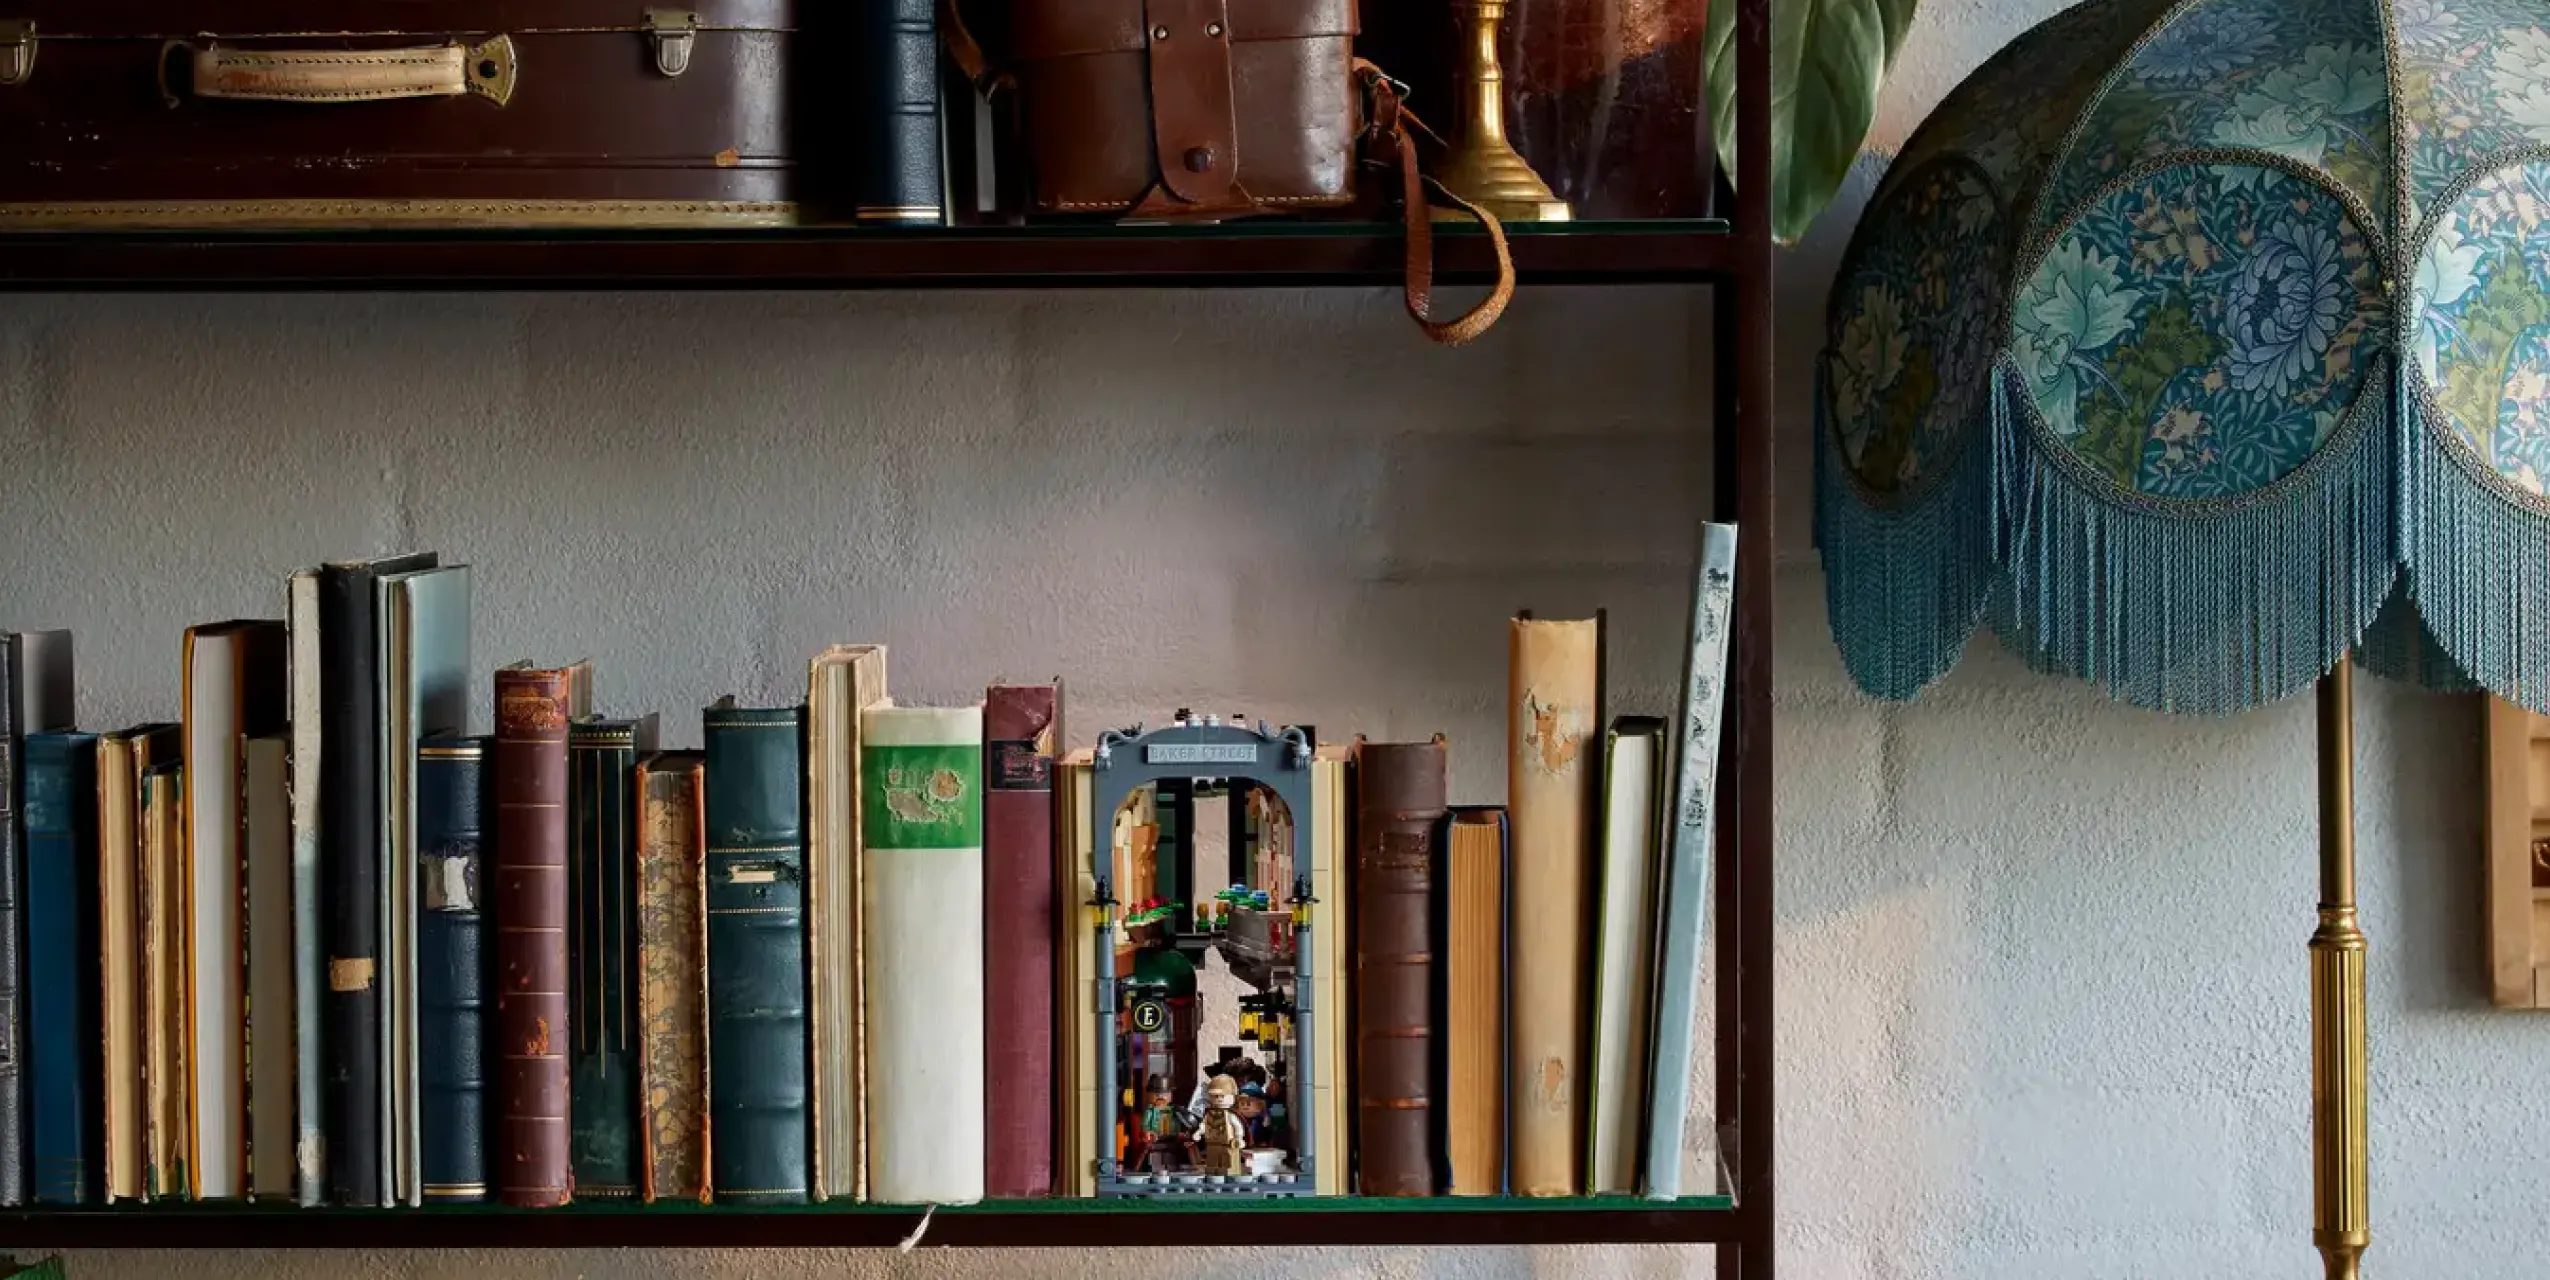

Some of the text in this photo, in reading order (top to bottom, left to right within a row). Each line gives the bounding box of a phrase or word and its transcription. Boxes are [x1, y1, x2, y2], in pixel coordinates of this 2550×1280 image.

[1152, 747, 1254, 760] BAKER STREET
[1143, 1007, 1153, 1025] E
